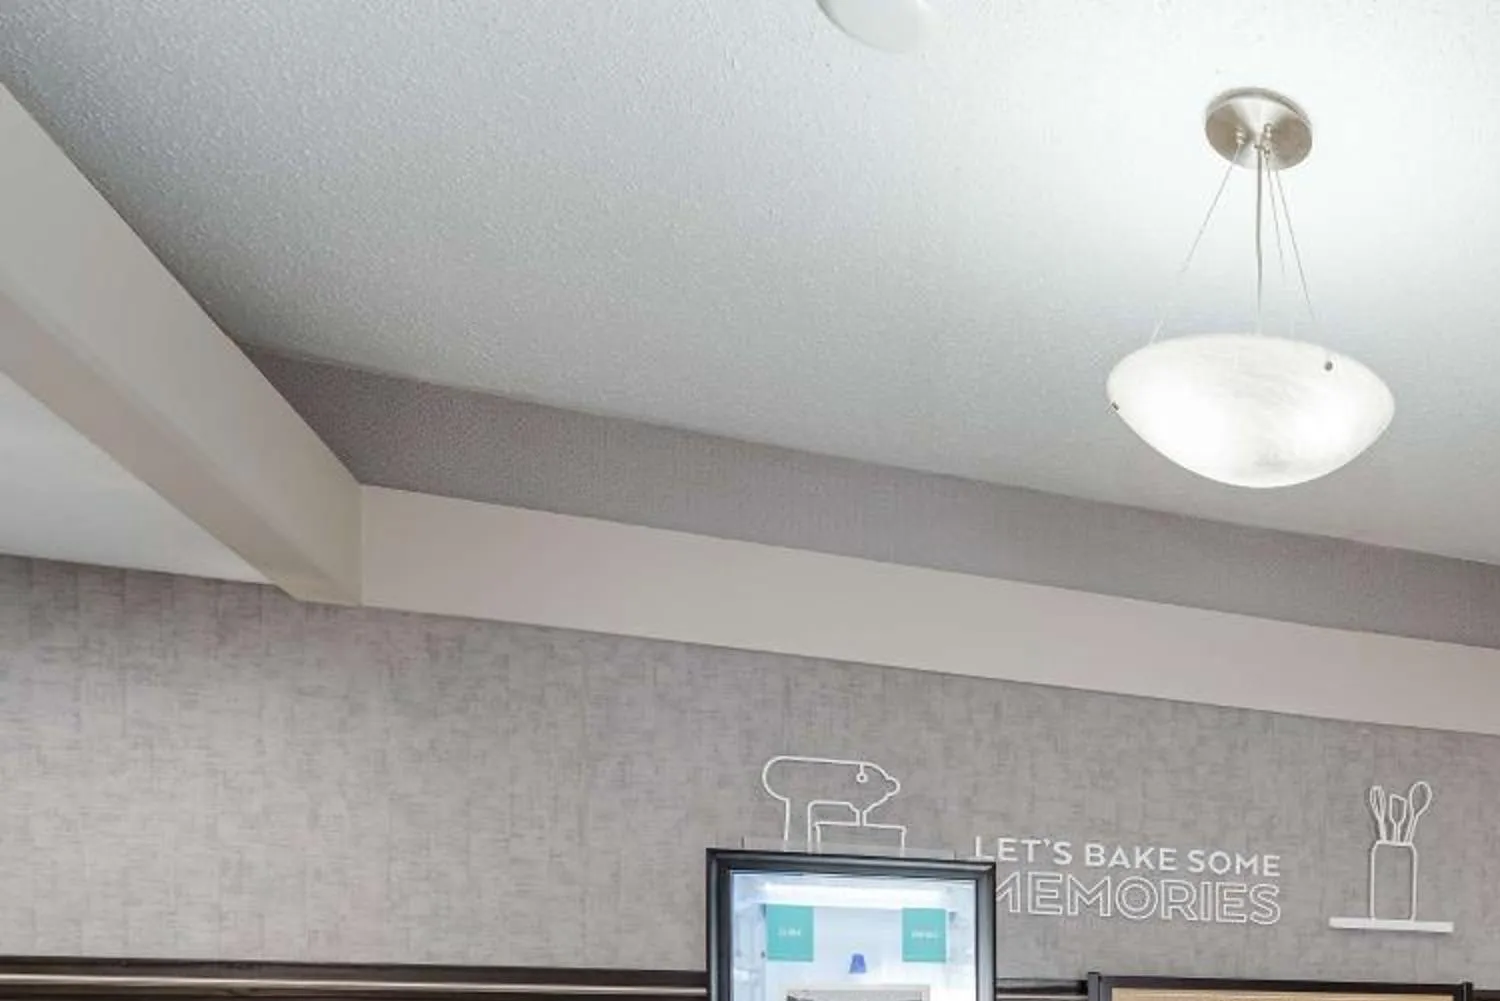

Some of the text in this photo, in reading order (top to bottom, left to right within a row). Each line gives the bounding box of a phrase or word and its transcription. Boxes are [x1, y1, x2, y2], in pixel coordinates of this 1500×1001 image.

[975, 836, 1280, 877] LET'S BAKE SOME
